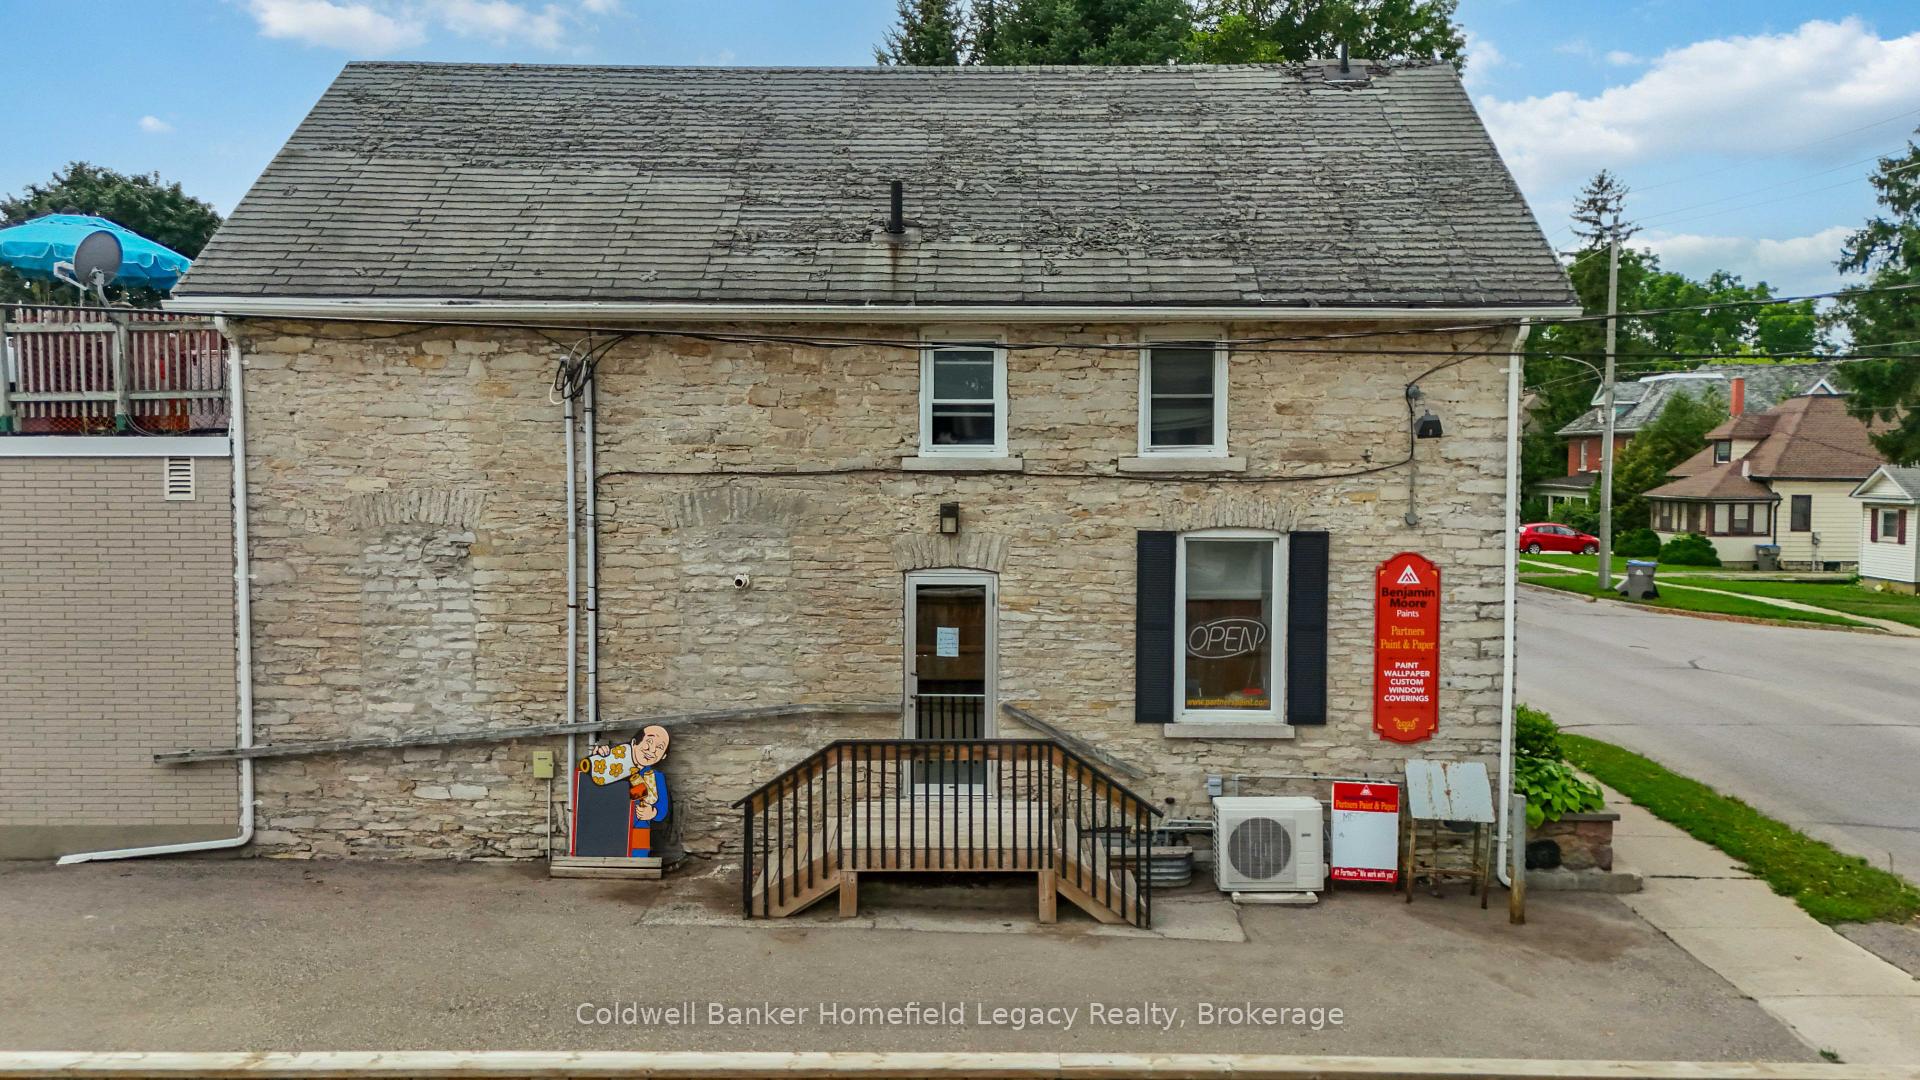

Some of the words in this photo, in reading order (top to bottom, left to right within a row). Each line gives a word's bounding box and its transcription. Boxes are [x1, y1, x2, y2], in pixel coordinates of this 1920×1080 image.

[1381, 587, 1435, 599] Benjamin
[1390, 598, 1427, 608] Moore
[1396, 609, 1420, 618] Paints
[1391, 625, 1425, 636] Partners
[1189, 626, 1260, 652] OPEN
[1380, 639, 1401, 649] Paint
[1403, 638, 1410, 649] &
[1412, 639, 1435, 652] Paper
[1395, 661, 1419, 669] PAINT
[1390, 678, 1424, 686] CUSTOM
[1388, 686, 1425, 694] WINDOW
[1384, 694, 1430, 702] COVERINGS
[1335, 800, 1358, 809] Partners
[1359, 800, 1373, 810] Paint
[1381, 801, 1396, 812] Paper
